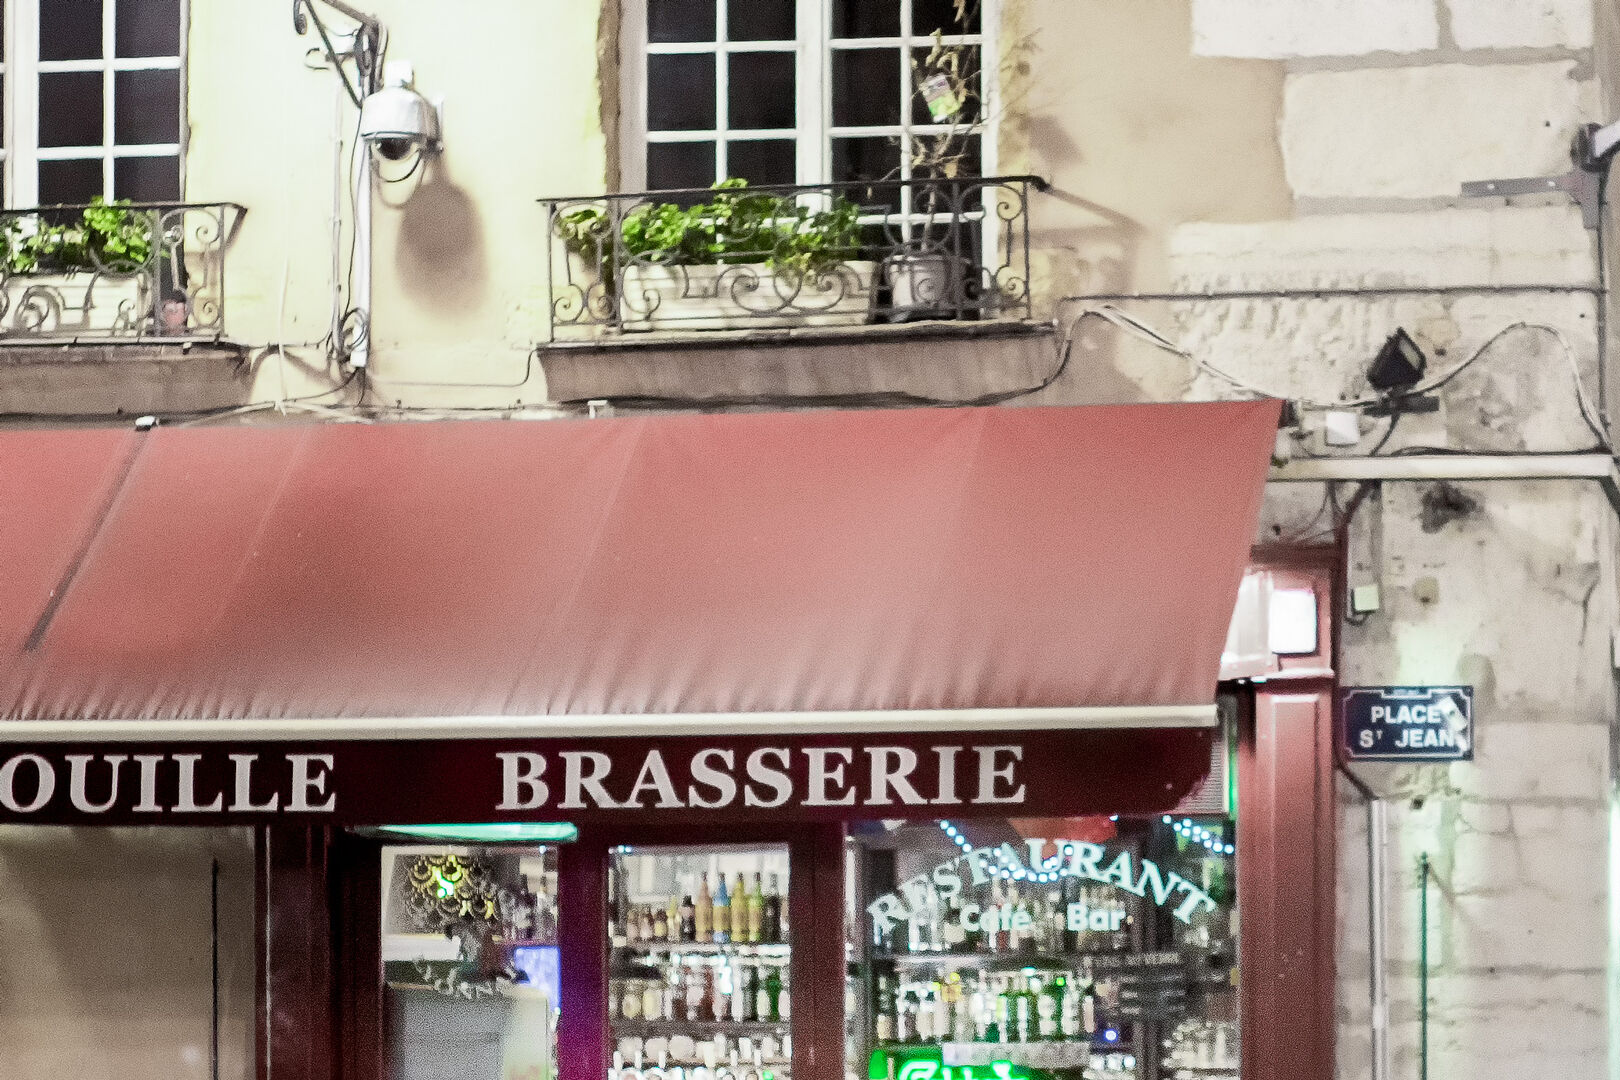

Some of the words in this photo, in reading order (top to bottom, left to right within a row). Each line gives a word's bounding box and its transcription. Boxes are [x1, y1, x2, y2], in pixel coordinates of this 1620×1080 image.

[1371, 705, 1442, 724] PLACE
[1395, 729, 1456, 748] JEAN
[0, 753, 338, 814] OUILLE
[495, 744, 1027, 811] BRASSERIE
[866, 837, 1217, 926] RESTAURANT
[1067, 901, 1126, 932] Bar
